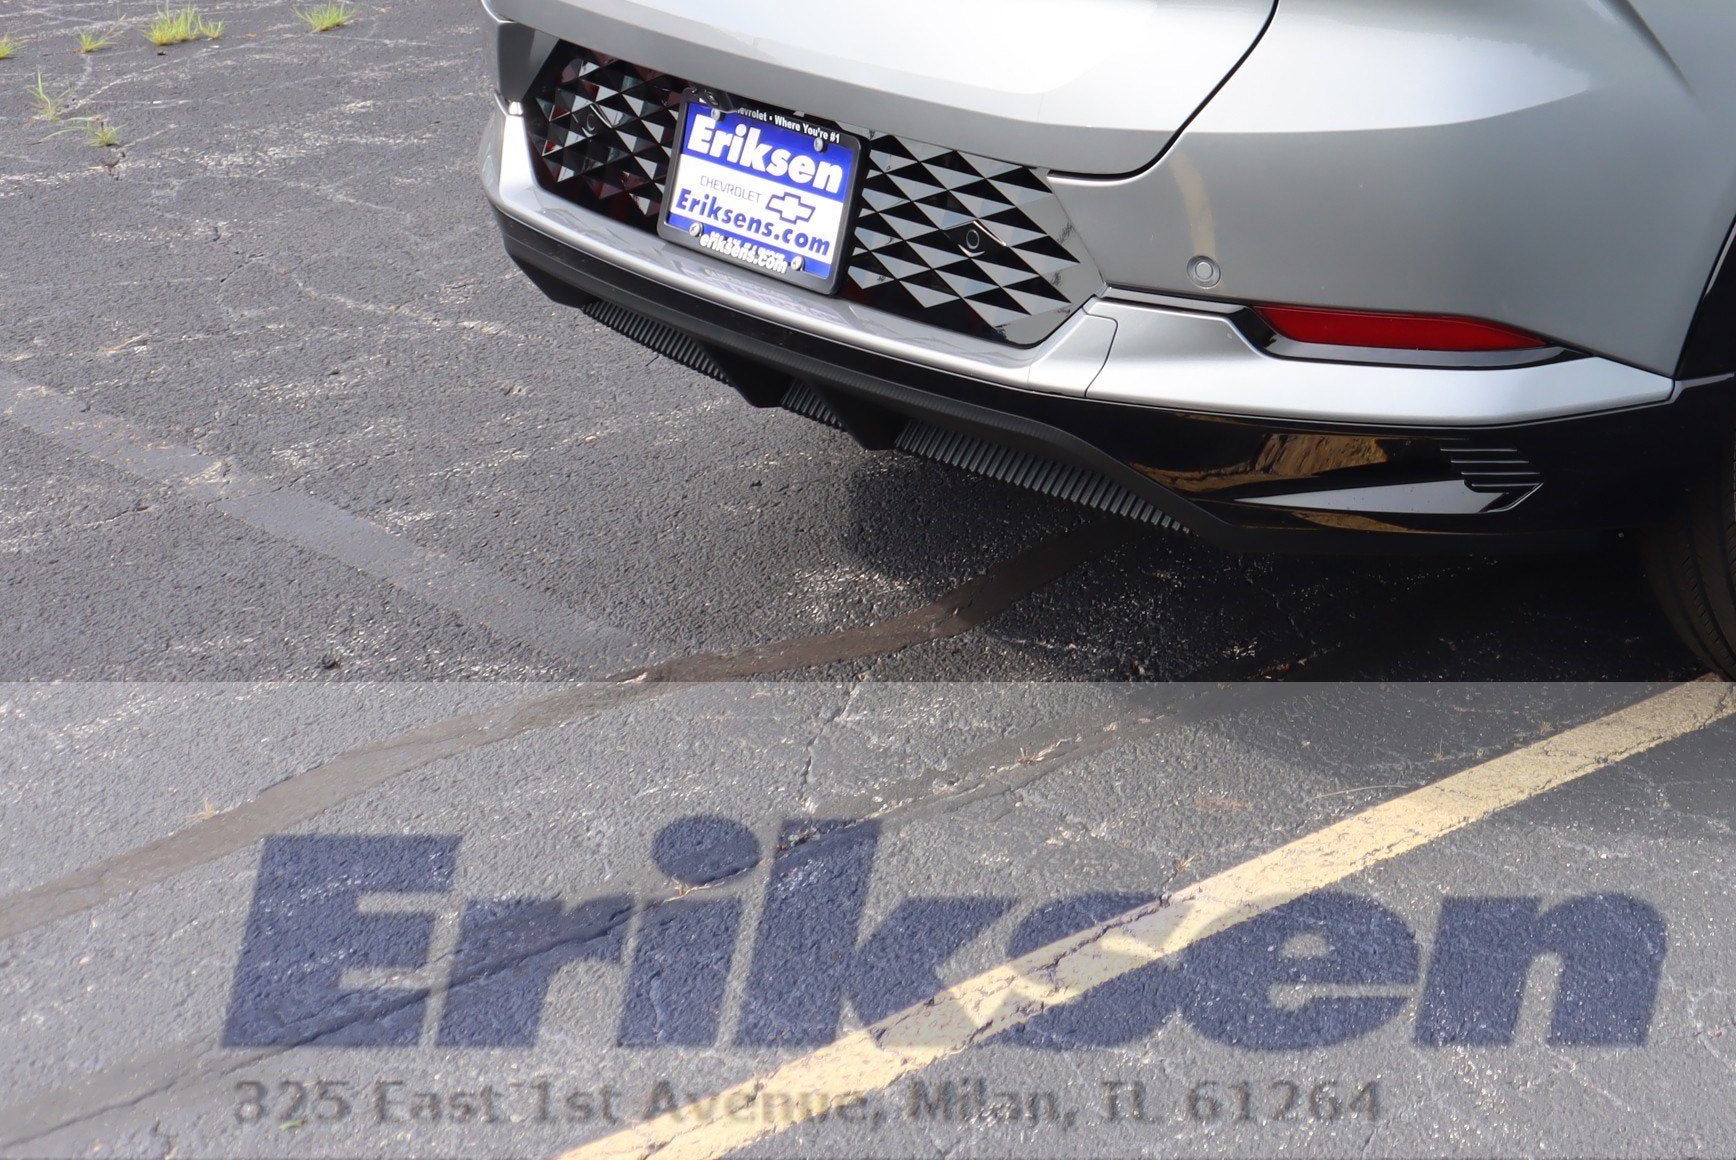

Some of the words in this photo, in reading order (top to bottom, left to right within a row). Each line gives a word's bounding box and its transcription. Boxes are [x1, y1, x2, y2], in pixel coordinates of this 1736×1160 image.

[736, 106, 768, 122] evrolet
[774, 114, 801, 132] Where
[803, 123, 829, 140] You're
[829, 133, 840, 143] #1
[687, 113, 843, 194] Eriksen
[699, 175, 764, 204] CHEVROLET
[675, 187, 831, 257] Eriksens.com
[700, 233, 788, 274] eriksens.com
